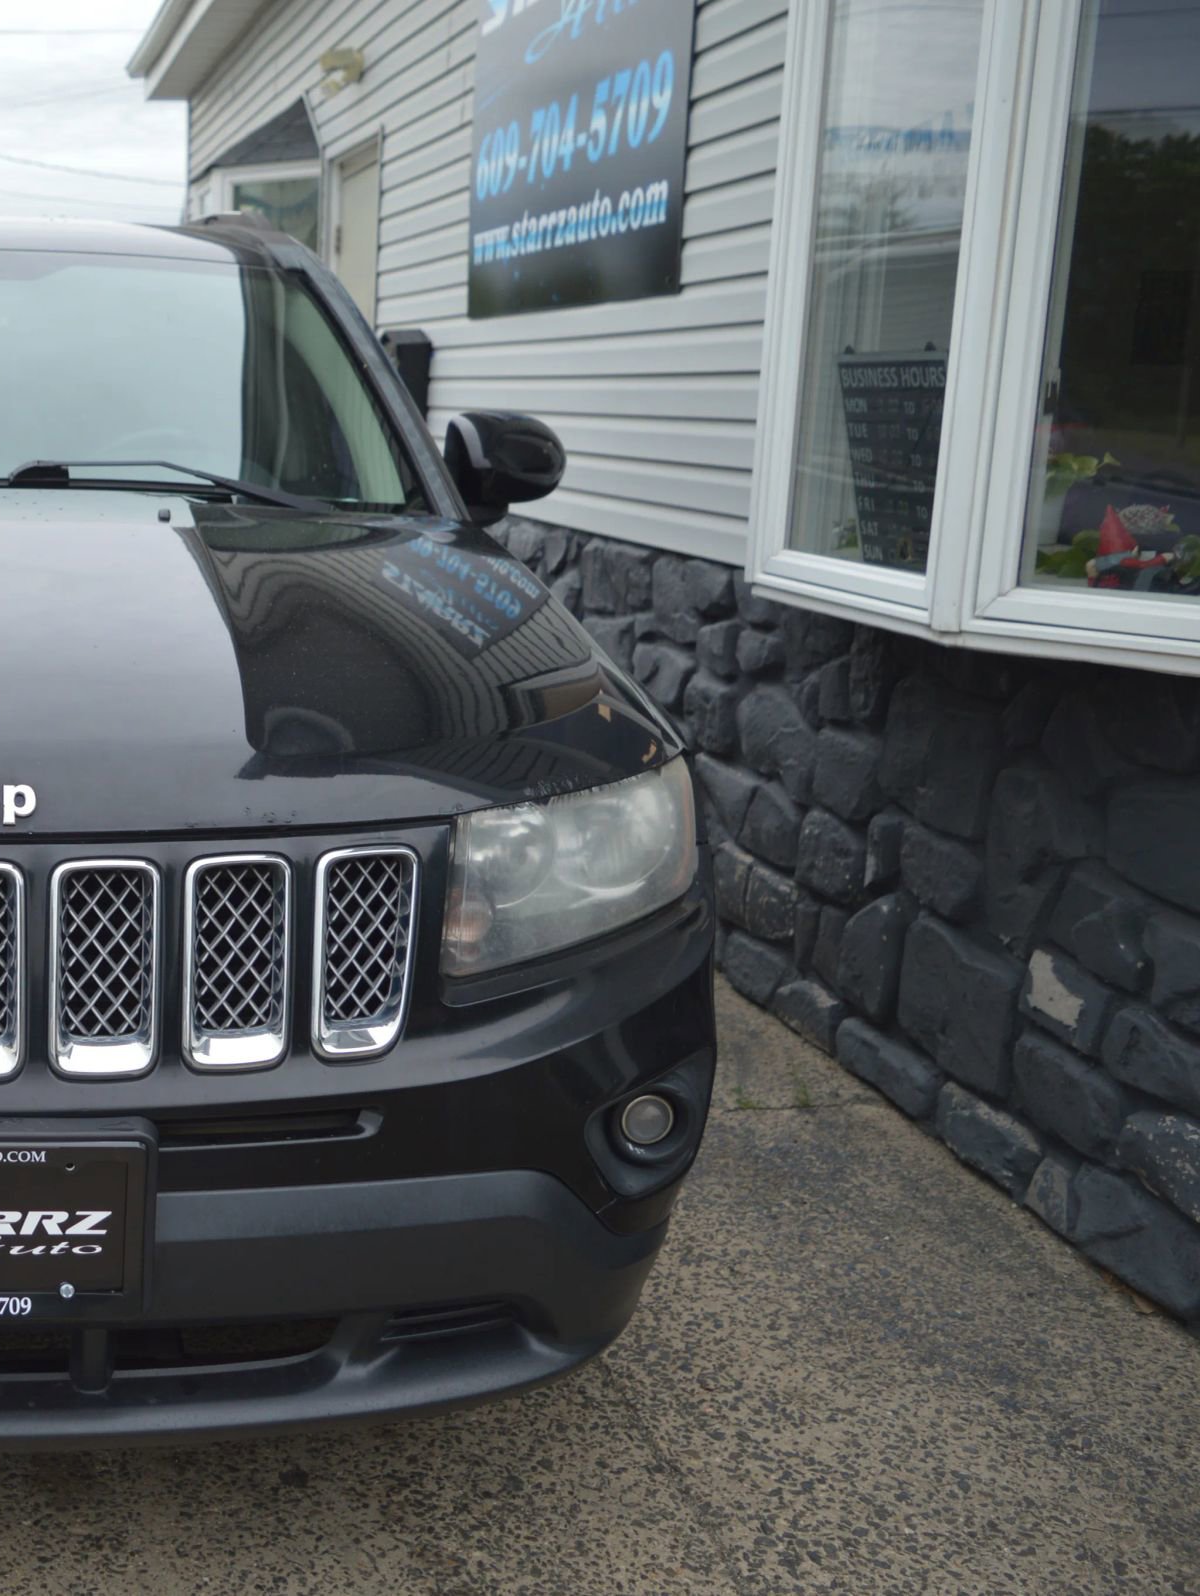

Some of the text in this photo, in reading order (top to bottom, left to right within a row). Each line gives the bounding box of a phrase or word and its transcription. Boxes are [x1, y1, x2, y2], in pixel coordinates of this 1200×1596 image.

[476, 48, 675, 202] 609-704-5709
[473, 178, 669, 266] www.starrzauto.com
[841, 366, 945, 388] BUSINESS HOURS
[845, 397, 868, 413] MON
[903, 401, 916, 415] TO
[848, 422, 869, 438] TUE
[906, 427, 919, 441] TO
[851, 448, 873, 463] WED
[910, 454, 922, 468] TO
[858, 496, 875, 512] FRI
[915, 505, 928, 520] TO
[860, 520, 879, 536] SAT
[863, 543, 884, 561] SUN
